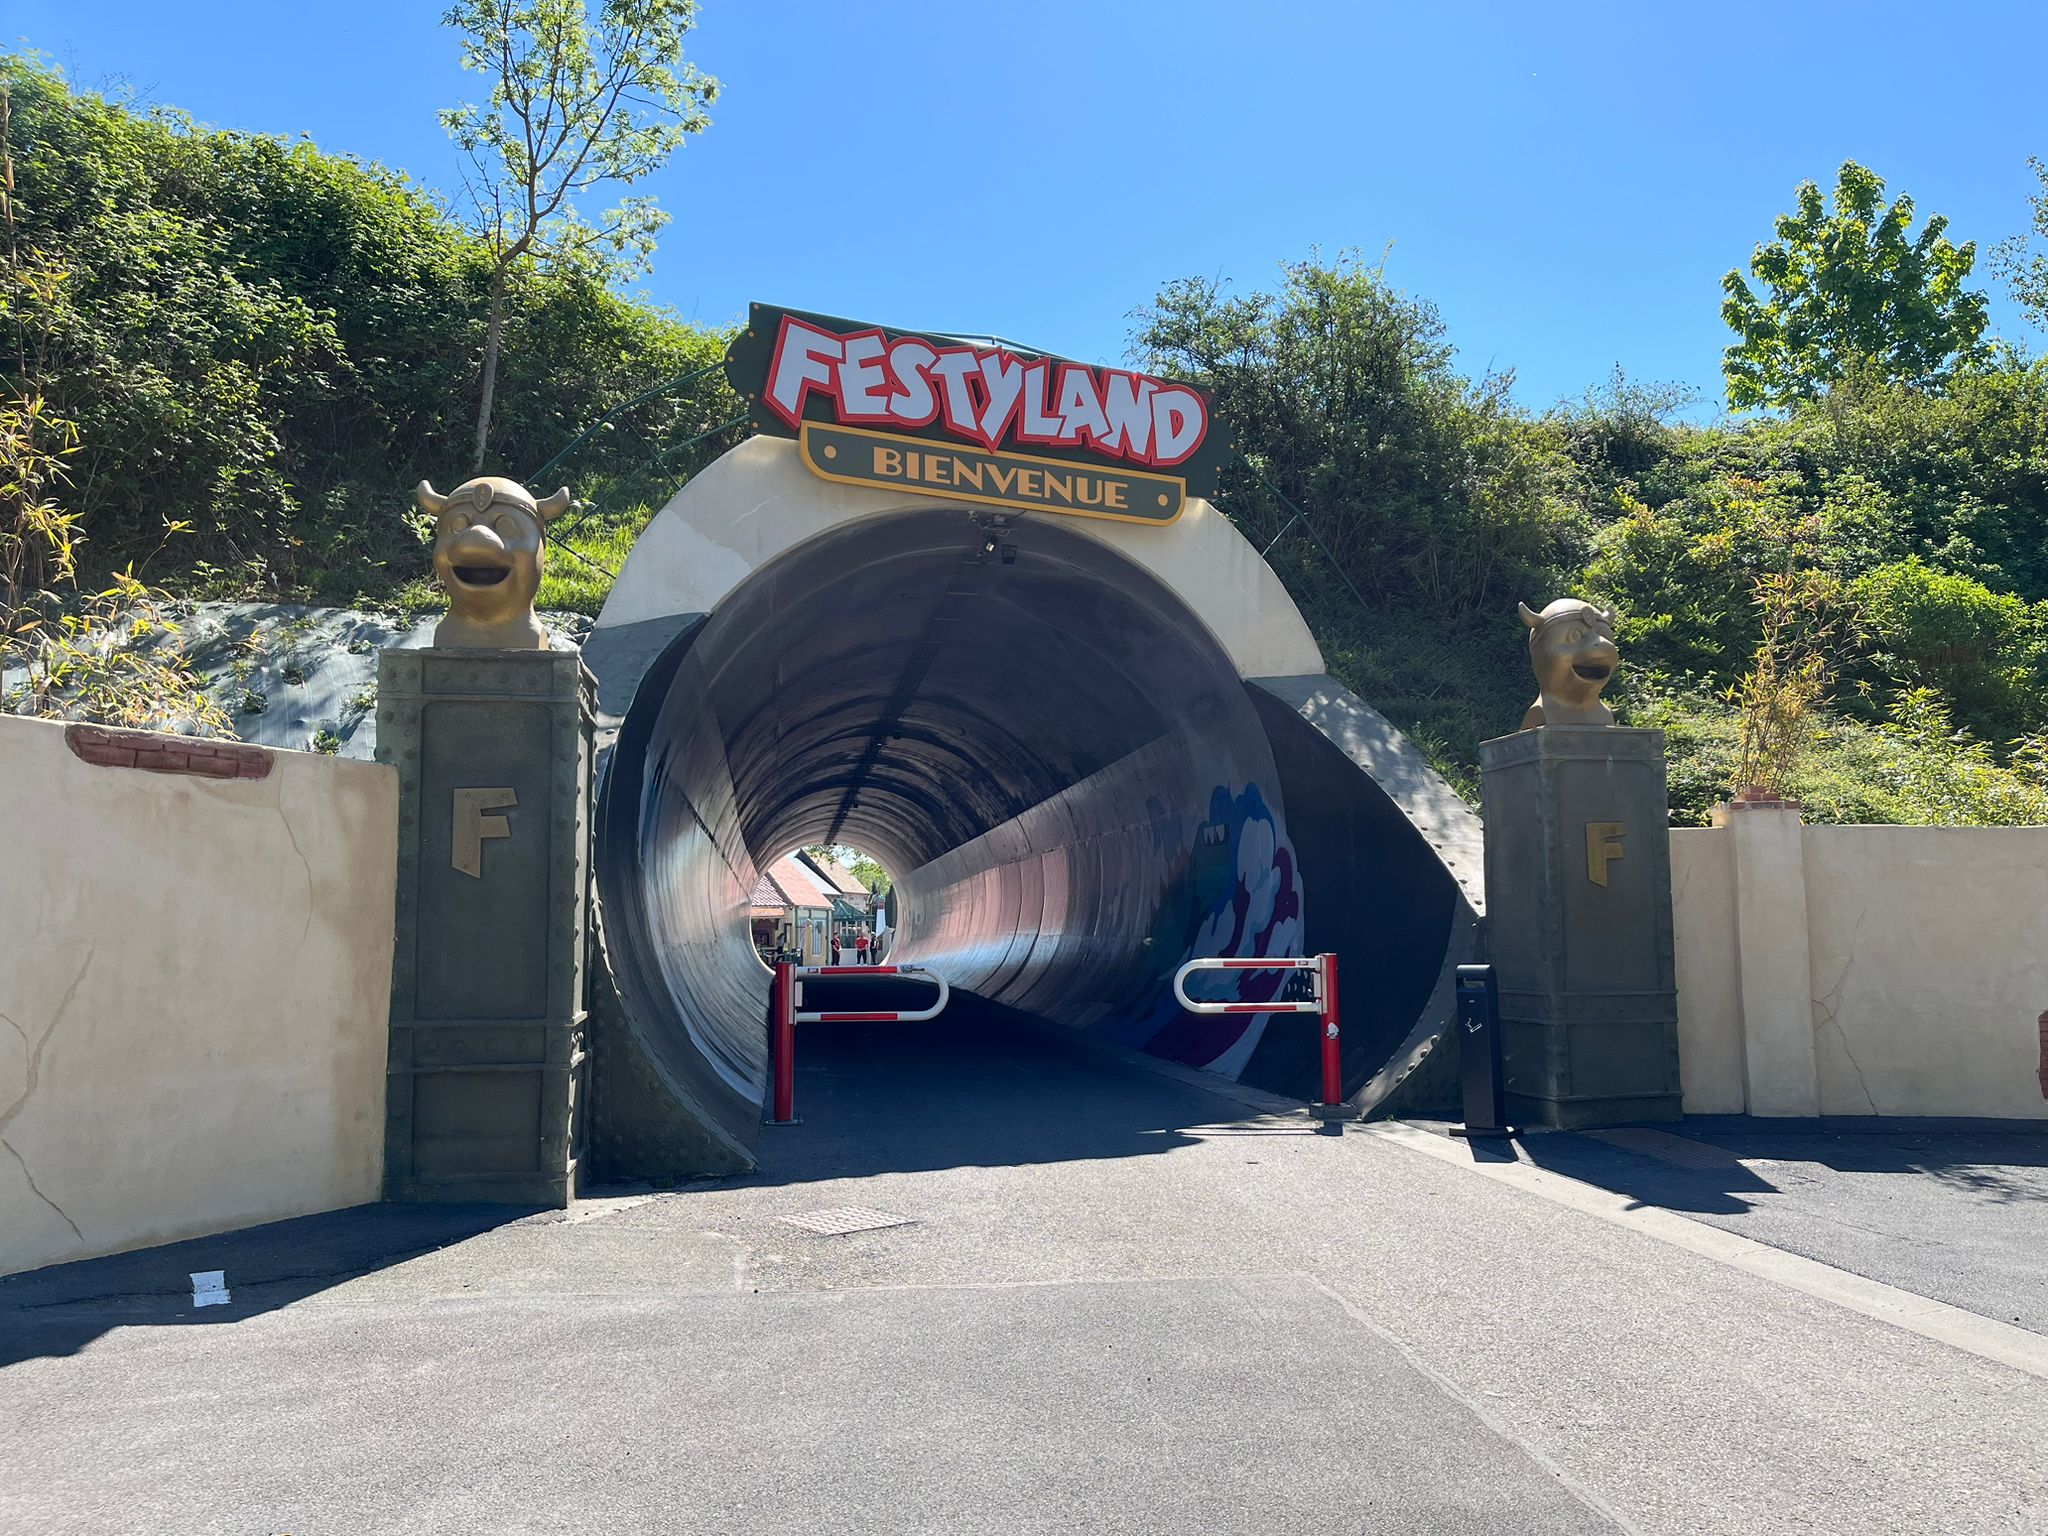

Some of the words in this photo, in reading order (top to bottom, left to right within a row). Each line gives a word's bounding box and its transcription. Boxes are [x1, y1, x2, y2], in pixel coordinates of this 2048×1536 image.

[768, 317, 1204, 463] FESTYLAND
[873, 446, 1128, 509] BIENVENUE
[451, 787, 518, 879] F
[1585, 822, 1628, 888] F
